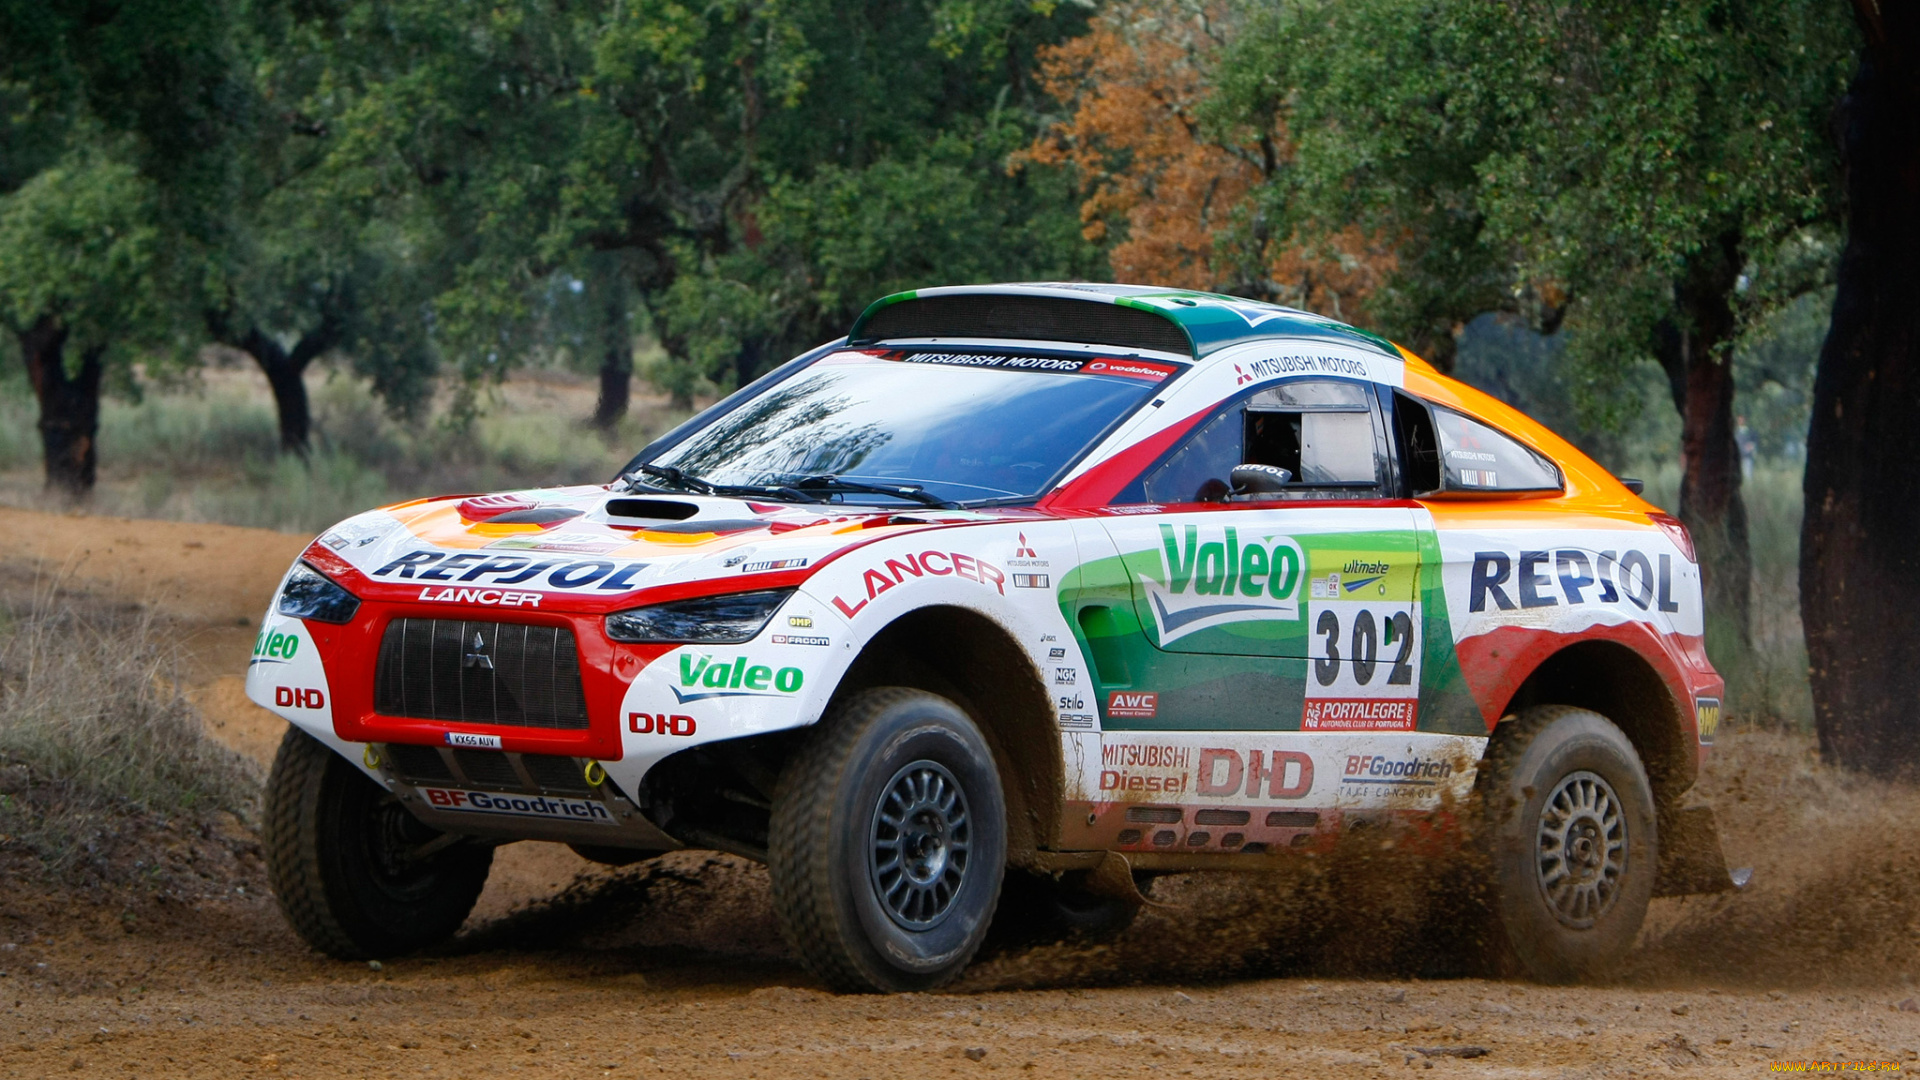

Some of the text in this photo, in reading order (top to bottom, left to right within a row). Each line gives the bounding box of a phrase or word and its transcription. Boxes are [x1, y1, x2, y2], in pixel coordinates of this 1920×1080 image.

[904, 353, 1084, 371] MITSUBISHI MOTORS
[1109, 364, 1169, 379] vodafone
[1250, 355, 1367, 379] MITSUBISHI MOTORS
[372, 549, 652, 591] REPSOL
[1158, 522, 1299, 600] Valeo
[1343, 559, 1390, 575] ultimate
[831, 549, 1006, 620] LANCER
[1328, 583, 1337, 591] OK
[1469, 549, 1679, 614] REPSOL
[418, 586, 543, 608] LANCER
[254, 625, 299, 660] aleo
[788, 636, 829, 646] FACOM
[1314, 608, 1413, 687] 302
[678, 653, 805, 693] Valeo
[1055, 667, 1076, 682] NGK
[1059, 693, 1084, 709] Stilo
[1112, 694, 1154, 708] AWC
[1321, 702, 1406, 719] PORTALEGRE
[1059, 713, 1093, 722] BOS
[1352, 720, 1367, 728] CLUB
[1367, 720, 1375, 728] DE
[1375, 720, 1405, 728] PORTUGAL
[454, 733, 495, 747] KX55 AUV
[1101, 743, 1191, 768] MITSUBISHI
[1345, 754, 1453, 779] BFGoodrich
[1099, 769, 1189, 794] Diesel
[1339, 786, 1434, 799] TAKE CONTROL
[426, 788, 608, 819] BFGoodrich
